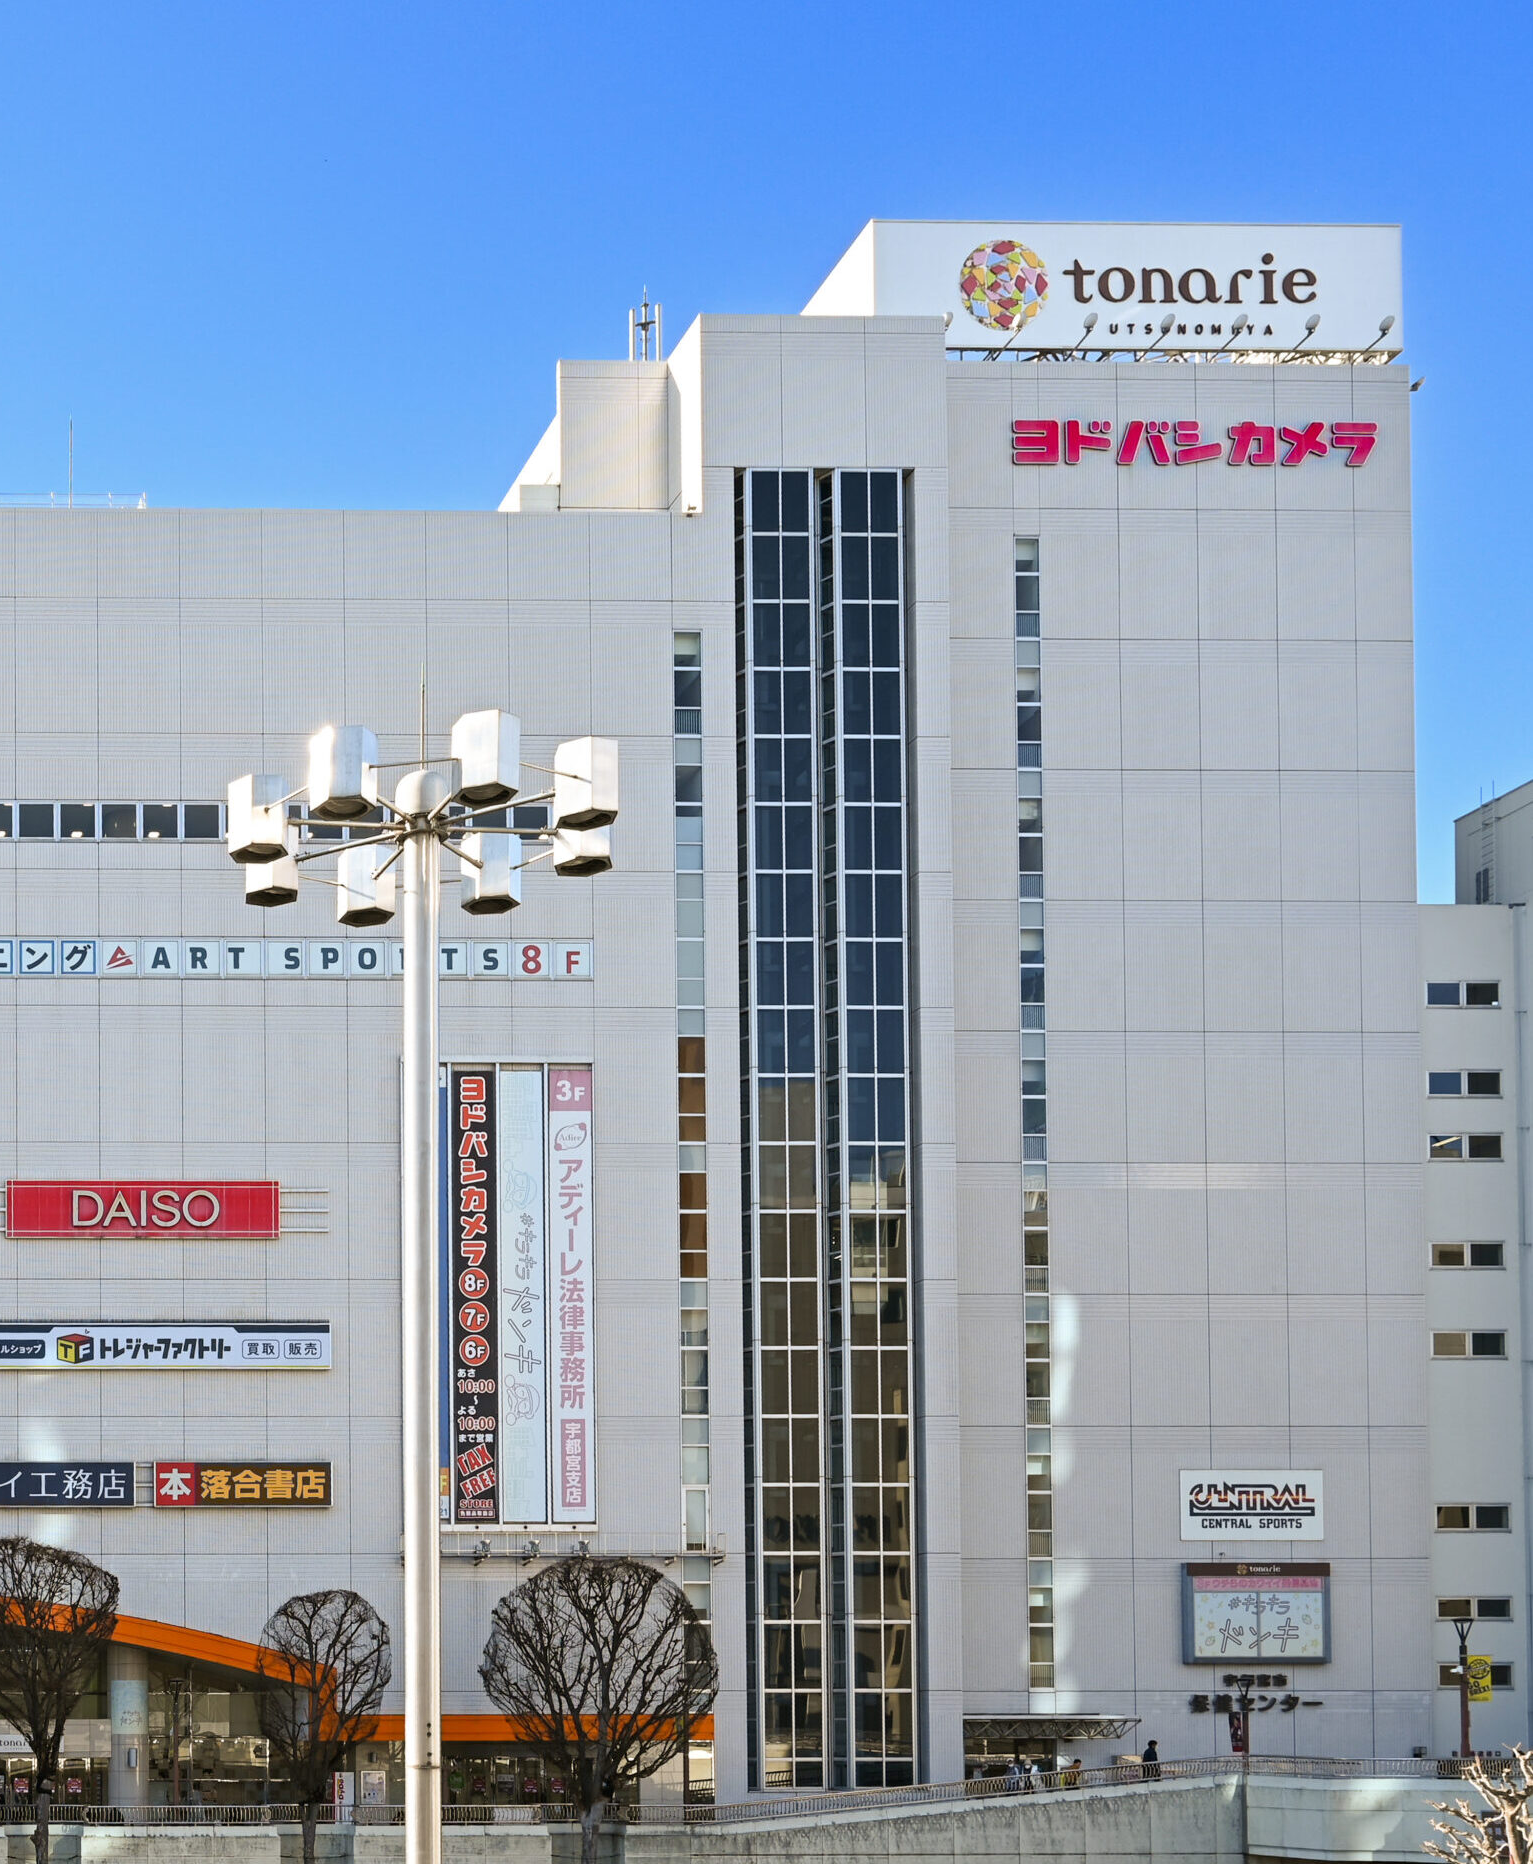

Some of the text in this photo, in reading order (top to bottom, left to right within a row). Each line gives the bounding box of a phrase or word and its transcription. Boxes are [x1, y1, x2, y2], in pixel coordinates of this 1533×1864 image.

[1062, 252, 1317, 304] tonarie
[1013, 419, 1378, 466] ヨドバシカメラ
[151, 946, 499, 970] ART SPOTS
[555, 1079, 586, 1101] 3F
[458, 1076, 487, 1267] ヨドバシカメラ
[72, 1189, 220, 1228] DAISO
[464, 1274, 485, 1292] 8F
[559, 1159, 586, 1409] アディーレ法律事務所
[464, 1308, 485, 1327] 7F
[99, 1337, 231, 1360] トレジャーファクトリー
[246, 1342, 319, 1356] 買取 販売
[464, 1340, 485, 1359] 6F
[457, 1368, 476, 1378] あさ
[457, 1379, 496, 1394] 10:00
[457, 1405, 476, 1415] よる
[457, 1416, 496, 1431] 10:00
[457, 1443, 493, 1476] TAX
[565, 1422, 583, 1504] 宇都宮支店
[159, 1468, 192, 1500] 本
[200, 1469, 326, 1500] 落合書店
[460, 1467, 496, 1499] FREE
[460, 1499, 493, 1508] STORE
[1201, 1518, 1302, 1529] CENTRAL SPORTS
[0, 1739, 26, 1747] tonar
